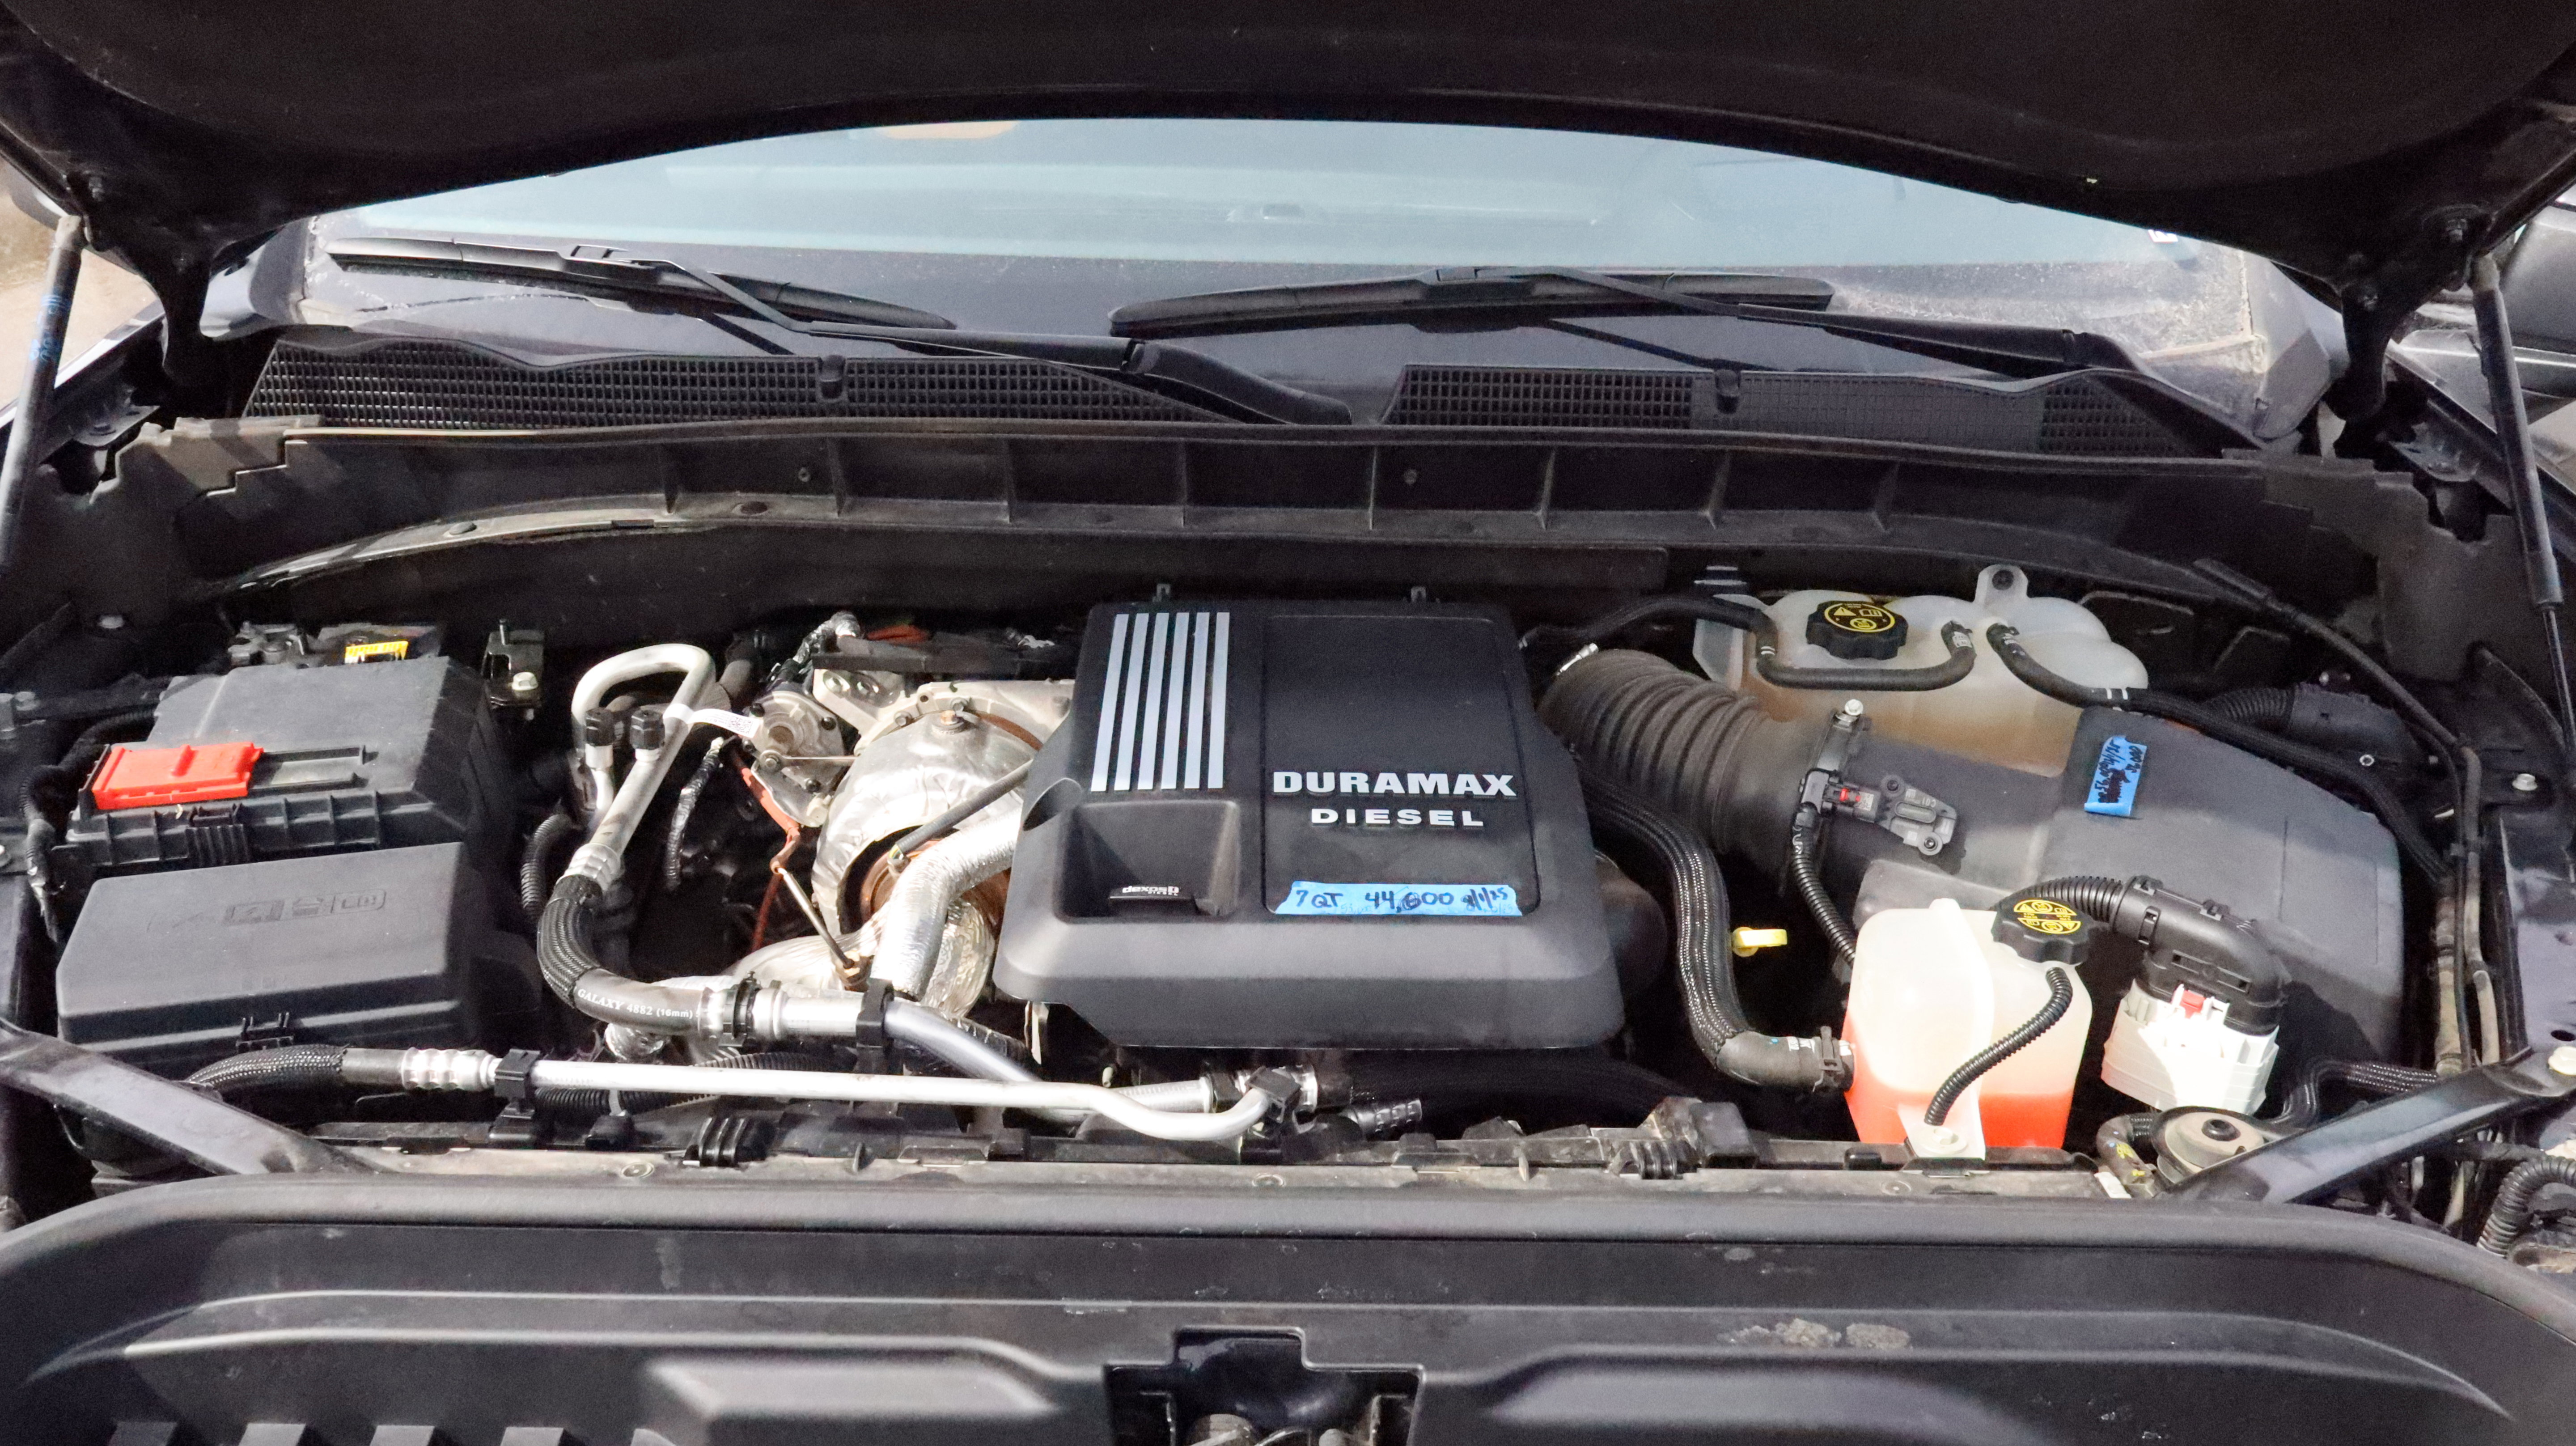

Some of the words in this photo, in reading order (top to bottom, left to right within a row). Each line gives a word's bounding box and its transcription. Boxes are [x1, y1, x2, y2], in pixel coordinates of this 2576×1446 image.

[1273, 771, 1517, 796] DURAMAX
[1311, 809, 1483, 826] DIESEL
[1296, 890, 1309, 907] 7
[1311, 893, 1344, 908] QT
[577, 988, 625, 1010] GALAXY
[627, 1003, 653, 1016] 4882
[656, 1008, 693, 1020] (16mm)
